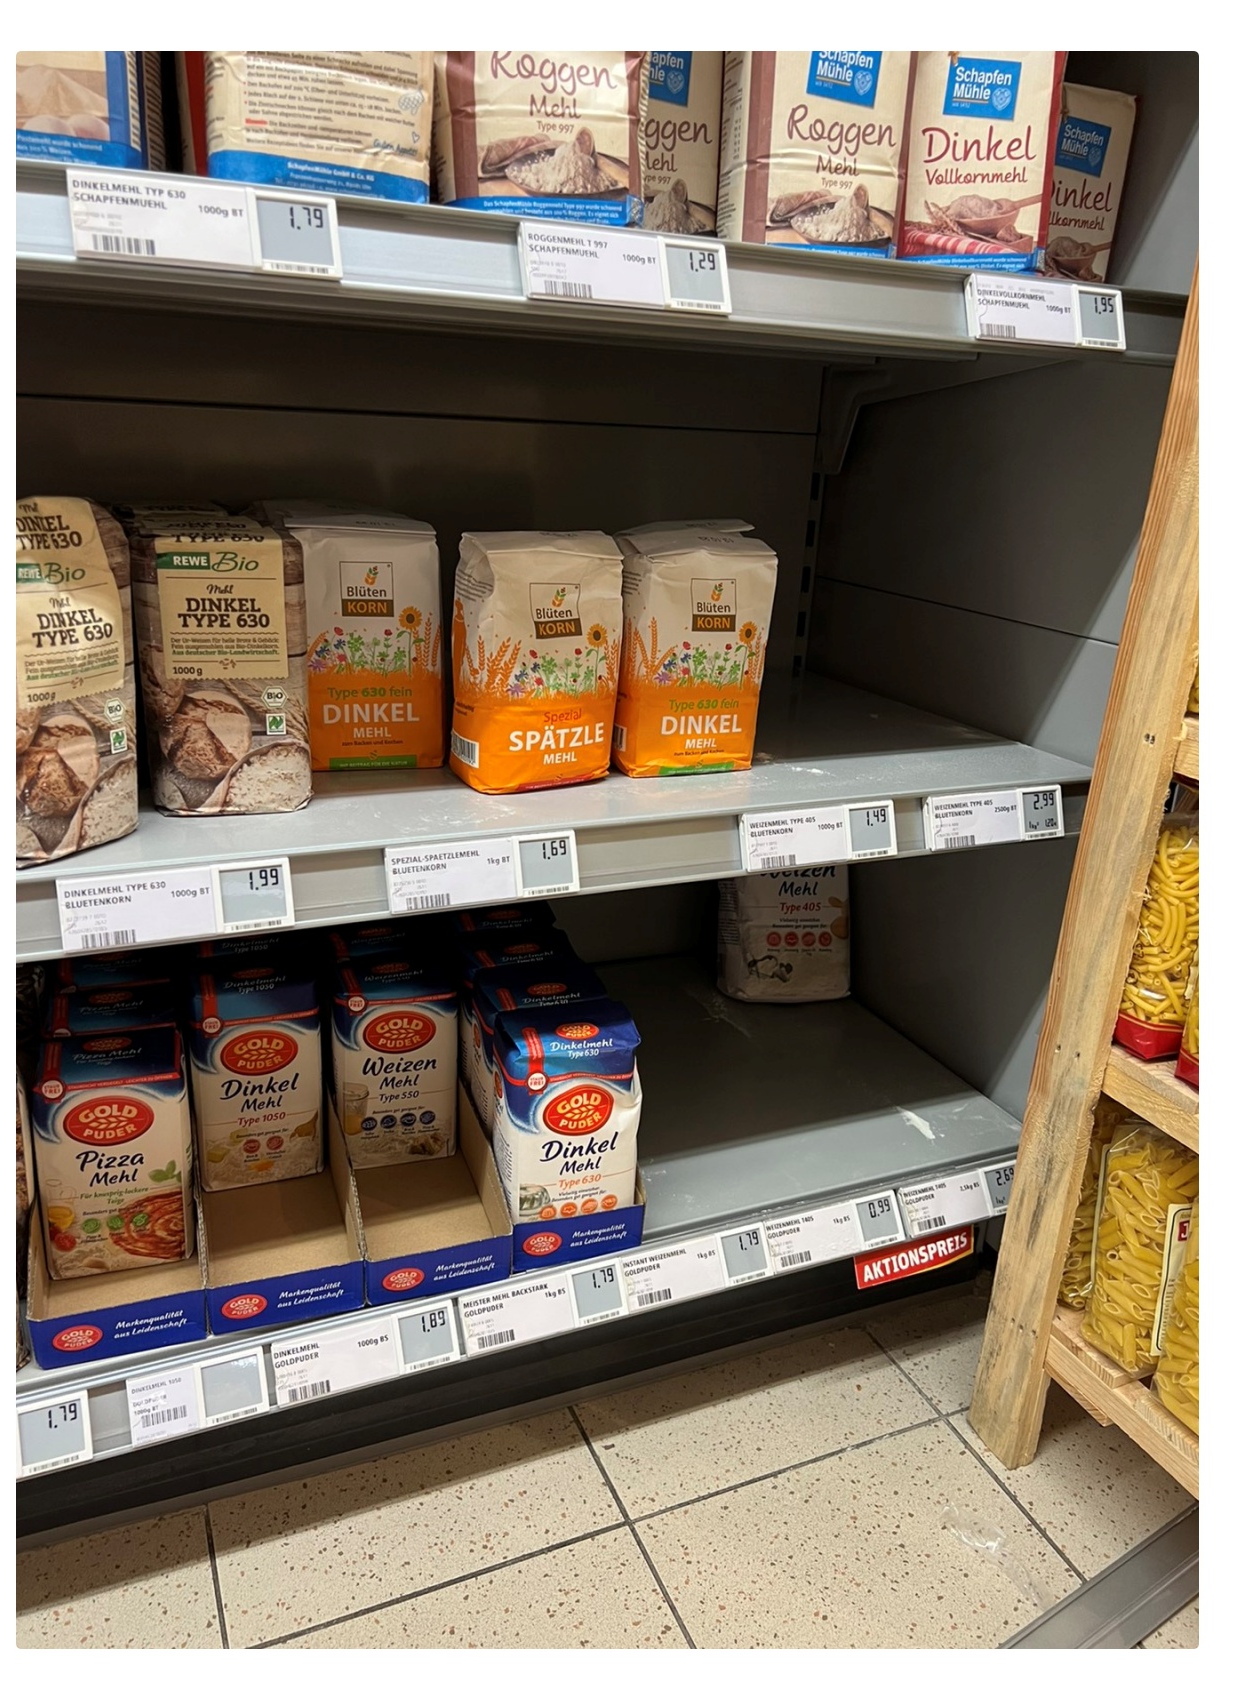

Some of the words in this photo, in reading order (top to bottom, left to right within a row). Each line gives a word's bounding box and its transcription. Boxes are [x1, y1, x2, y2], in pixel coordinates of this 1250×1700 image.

[491, 51, 618, 95] Roggen
[816, 61, 854, 82] Mühle
[955, 67, 1013, 86] Schapfen
[953, 81, 991, 100] Mühle
[529, 94, 581, 120] Mehl
[537, 120, 557, 133] Type
[558, 124, 575, 135] 997
[787, 104, 897, 156] Roggen
[1064, 124, 1104, 146] Schapfen
[922, 125, 1036, 164] Dinkel
[816, 155, 860, 176] Mehl
[925, 166, 1028, 186] Vollkornmehl
[72, 180, 142, 195] DINKELMEHL
[146, 187, 165, 197] TYP
[167, 189, 186, 199] 630
[528, 233, 585, 247] ROGGENMEHL
[593, 241, 608, 249] 997
[173, 556, 208, 566] REWE
[211, 551, 259, 573] Bio
[44, 562, 86, 585] Bio
[347, 586, 387, 599] Blüten
[185, 598, 261, 612] DINKEL
[347, 601, 387, 614] KORN
[535, 605, 573, 620] Blüten
[696, 601, 732, 614] Blüten
[36, 608, 103, 630] DINKEL
[178, 613, 230, 628] TYPE
[236, 613, 270, 628] 630
[697, 616, 731, 629] KORN
[32, 628, 79, 648] TYPE
[84, 623, 113, 642] 630
[539, 621, 576, 636] KORN
[172, 667, 195, 675] 1000
[327, 688, 359, 701] Type
[361, 687, 386, 697] 630
[323, 703, 420, 724] DINKEL
[669, 699, 694, 713] Type
[697, 699, 718, 710] 630
[544, 708, 582, 725] Spezial
[660, 714, 742, 735] DINKEL
[353, 727, 392, 738] MEHL
[509, 722, 605, 752] SPÄTZLE
[685, 738, 717, 749] MEHL
[543, 751, 578, 765] MEHL
[1033, 793, 1054, 810] 2.99
[750, 819, 789, 829] WEIZENMEHL
[866, 809, 886, 827] 1.49
[818, 823, 835, 831] 1000g
[391, 850, 480, 865] SPEZIAL-SPAETZLEMEHL
[542, 839, 567, 860] 1.69
[501, 856, 510, 864] BT
[249, 868, 279, 891] 1.99
[64, 885, 123, 899] DINKELMEHL
[125, 882, 148, 893] TYPE
[150, 881, 167, 890] 630
[778, 881, 818, 897] Mehl
[238, 987, 253, 995] Type
[376, 1018, 424, 1034] GOLD
[233, 1038, 285, 1055] GOLD
[378, 1035, 422, 1048] PUDER
[550, 1038, 613, 1052] Dinkelmehl
[72, 1053, 106, 1061] Pizza
[584, 1048, 600, 1056] 630
[237, 1055, 283, 1069] PUDER
[362, 1056, 437, 1077] Weizen
[220, 1072, 300, 1100] Dinkel
[379, 1074, 420, 1090] Mehl
[241, 1095, 283, 1113] Mehl
[379, 1094, 400, 1104] Type
[556, 1092, 602, 1114] GOLD
[79, 1104, 138, 1122] GOLD
[262, 1111, 286, 1122] 1050
[558, 1111, 602, 1129] PUDER
[83, 1123, 137, 1139] PUDER
[539, 1131, 619, 1163] Dinkel
[76, 1150, 145, 1172] Pizza
[559, 1156, 602, 1176] Mehl
[90, 1168, 138, 1187] Mehl
[581, 1173, 602, 1184] 630
[868, 1199, 891, 1218] 0.99
[572, 1223, 626, 1239] Markenqualität
[435, 1255, 493, 1273] Markenqualität
[697, 1252, 708, 1260] 1kg
[863, 1232, 968, 1283] AKTIONSPREIS
[591, 1267, 615, 1289] 1.79
[624, 1263, 661, 1277] GOLDPUDER
[278, 1281, 342, 1299] Markenqualität
[277, 1300, 292, 1308] aus
[464, 1302, 504, 1319] GOLDPUDER
[115, 1309, 184, 1330] Markenqualität
[422, 1311, 446, 1334] 1.89
[114, 1331, 131, 1339] aus
[273, 1342, 320, 1360] DINKELMEHL
[274, 1351, 319, 1369] GOLDPUDER
[168, 1377, 182, 1385] 1050
[48, 1402, 77, 1429] 1.79
